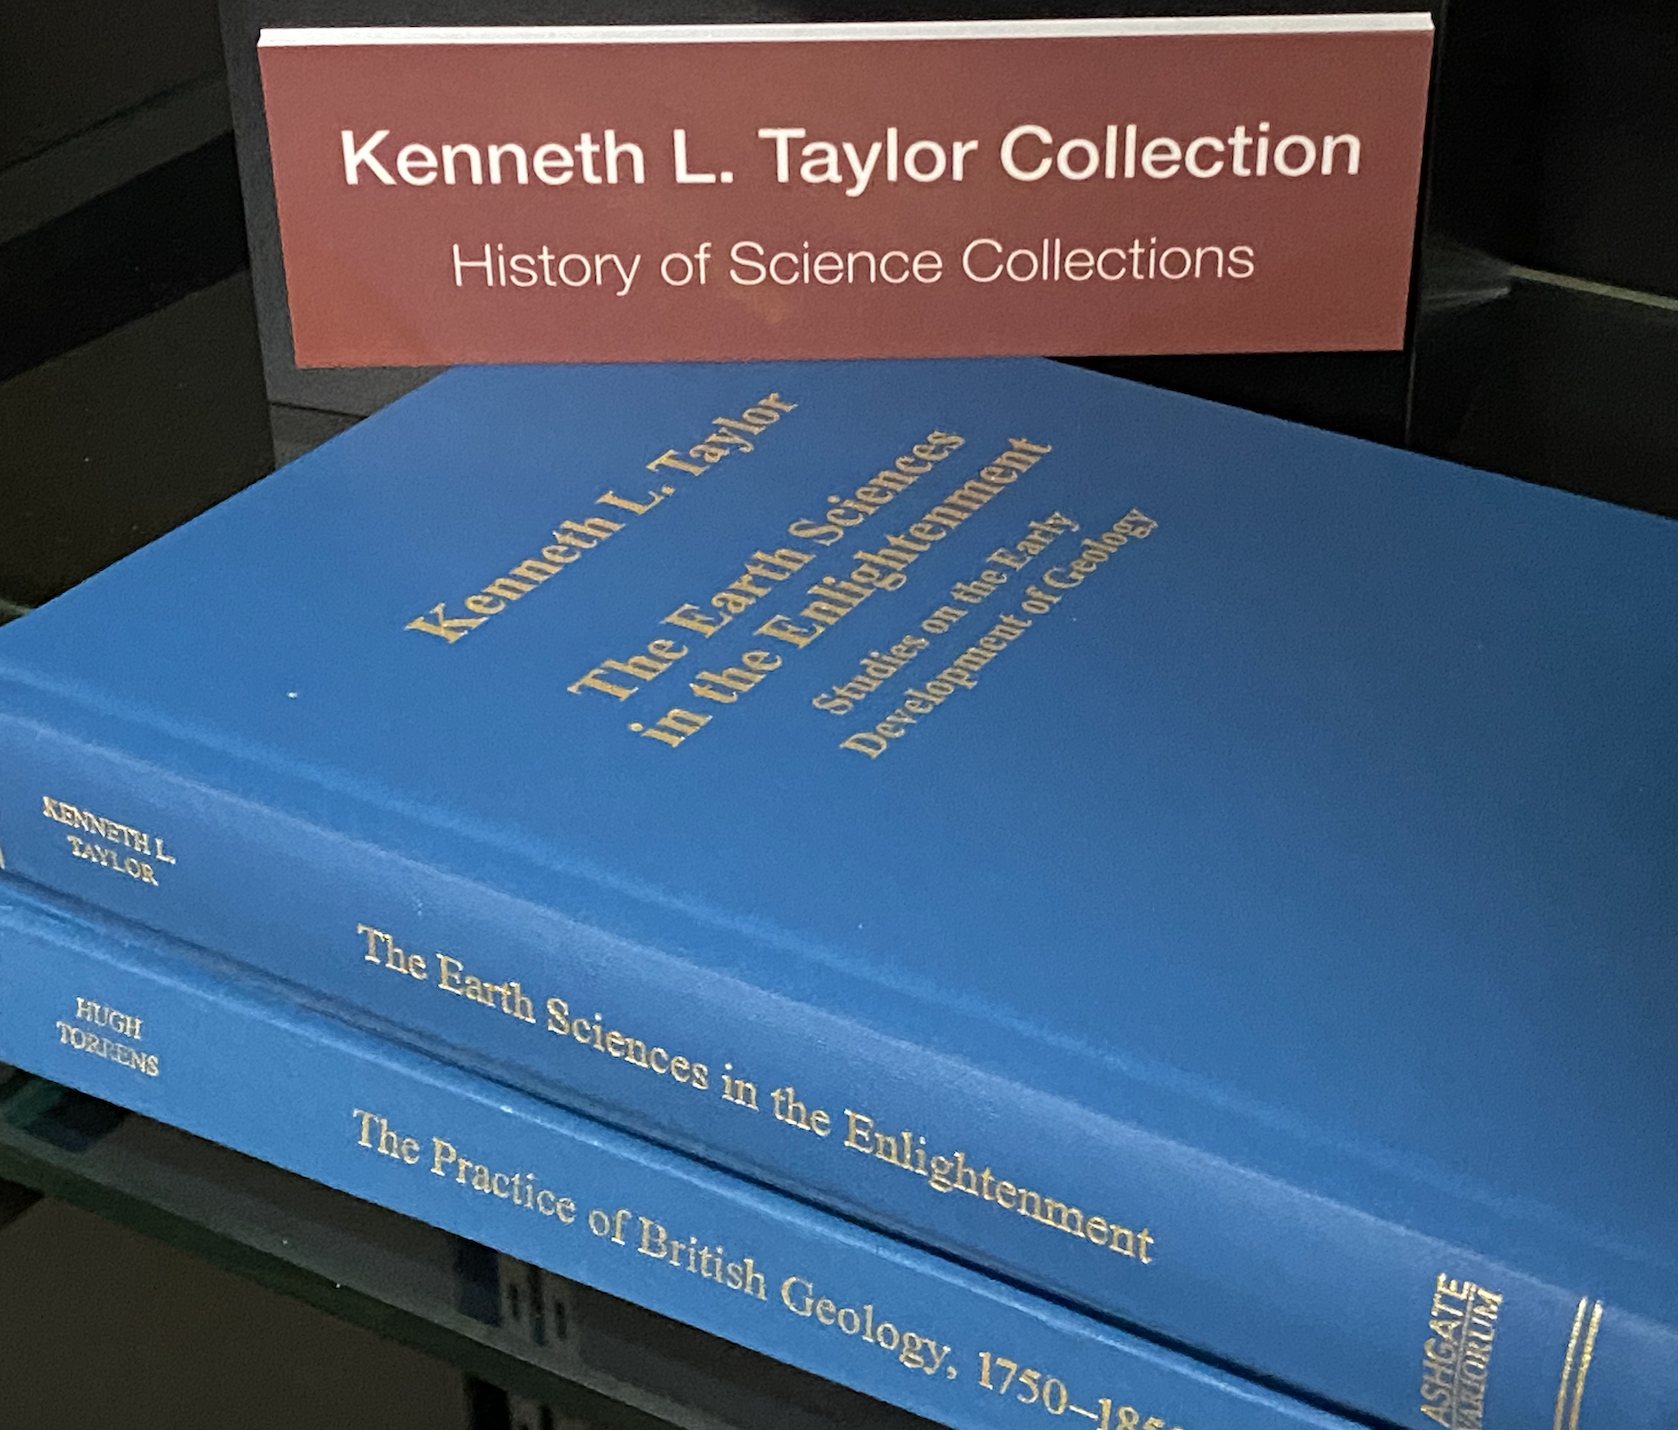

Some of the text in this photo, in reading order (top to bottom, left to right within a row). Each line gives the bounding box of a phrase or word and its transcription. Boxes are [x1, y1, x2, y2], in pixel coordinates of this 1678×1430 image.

[340, 121, 1362, 198] Kenneth L. Taylor Collection
[452, 237, 1255, 297] History of Science Collections
[405, 392, 798, 644] Kenneth L. Taylor
[567, 430, 966, 702] The Earth Sciences
[628, 436, 1053, 748] in the Enlightenment
[812, 510, 1080, 716] Studies on the Early
[839, 507, 1159, 760] Development of Geology
[42, 796, 177, 865] KENNETH L.
[67, 835, 160, 887] TAYLOR
[76, 996, 143, 1040] HUGH
[356, 923, 1155, 1265] The Earth Sciences in the Enlightenment
[352, 1107, 421, 1164] The
[430, 1136, 578, 1225] Practice
[587, 1208, 633, 1246] of
[636, 1215, 768, 1301] British
[780, 1275, 957, 1381] Geology,
[1420, 1272, 1472, 1429] ASHGATE
